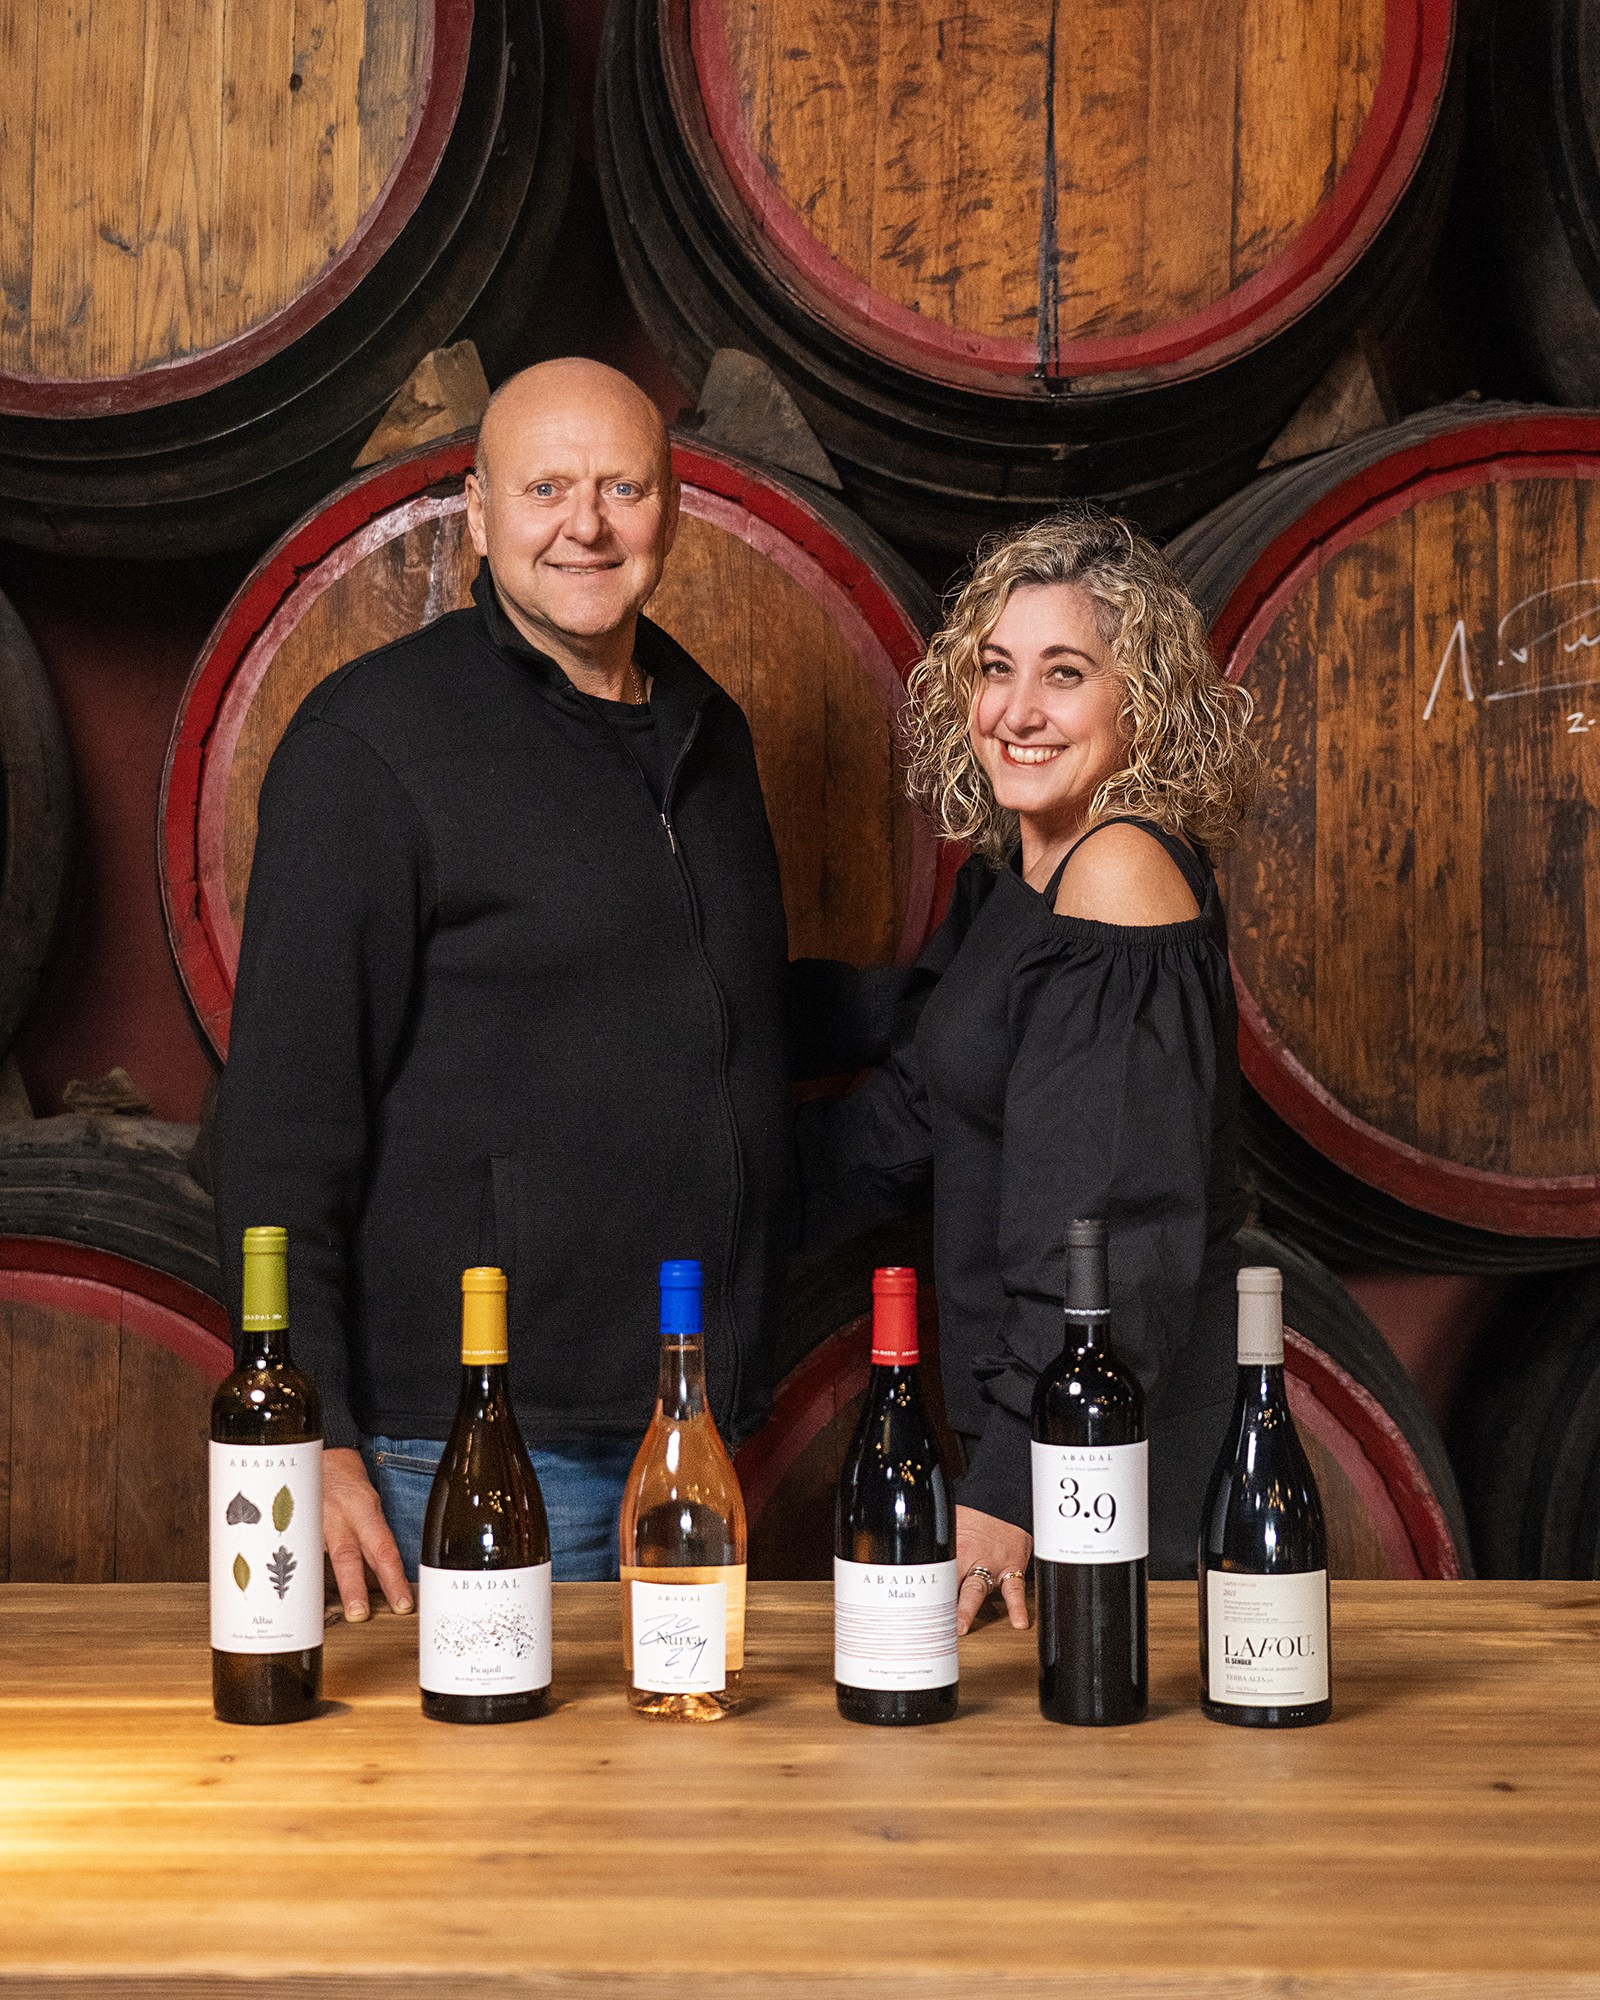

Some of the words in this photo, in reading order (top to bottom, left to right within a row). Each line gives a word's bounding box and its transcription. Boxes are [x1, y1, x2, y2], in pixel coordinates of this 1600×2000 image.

[229, 1457, 298, 1468] ABADAL
[1061, 1453, 1113, 1461] ABADAL
[1058, 1477, 1117, 1534] 3.9
[450, 1578, 520, 1590] ABADAL
[863, 1573, 939, 1585] ABADAL
